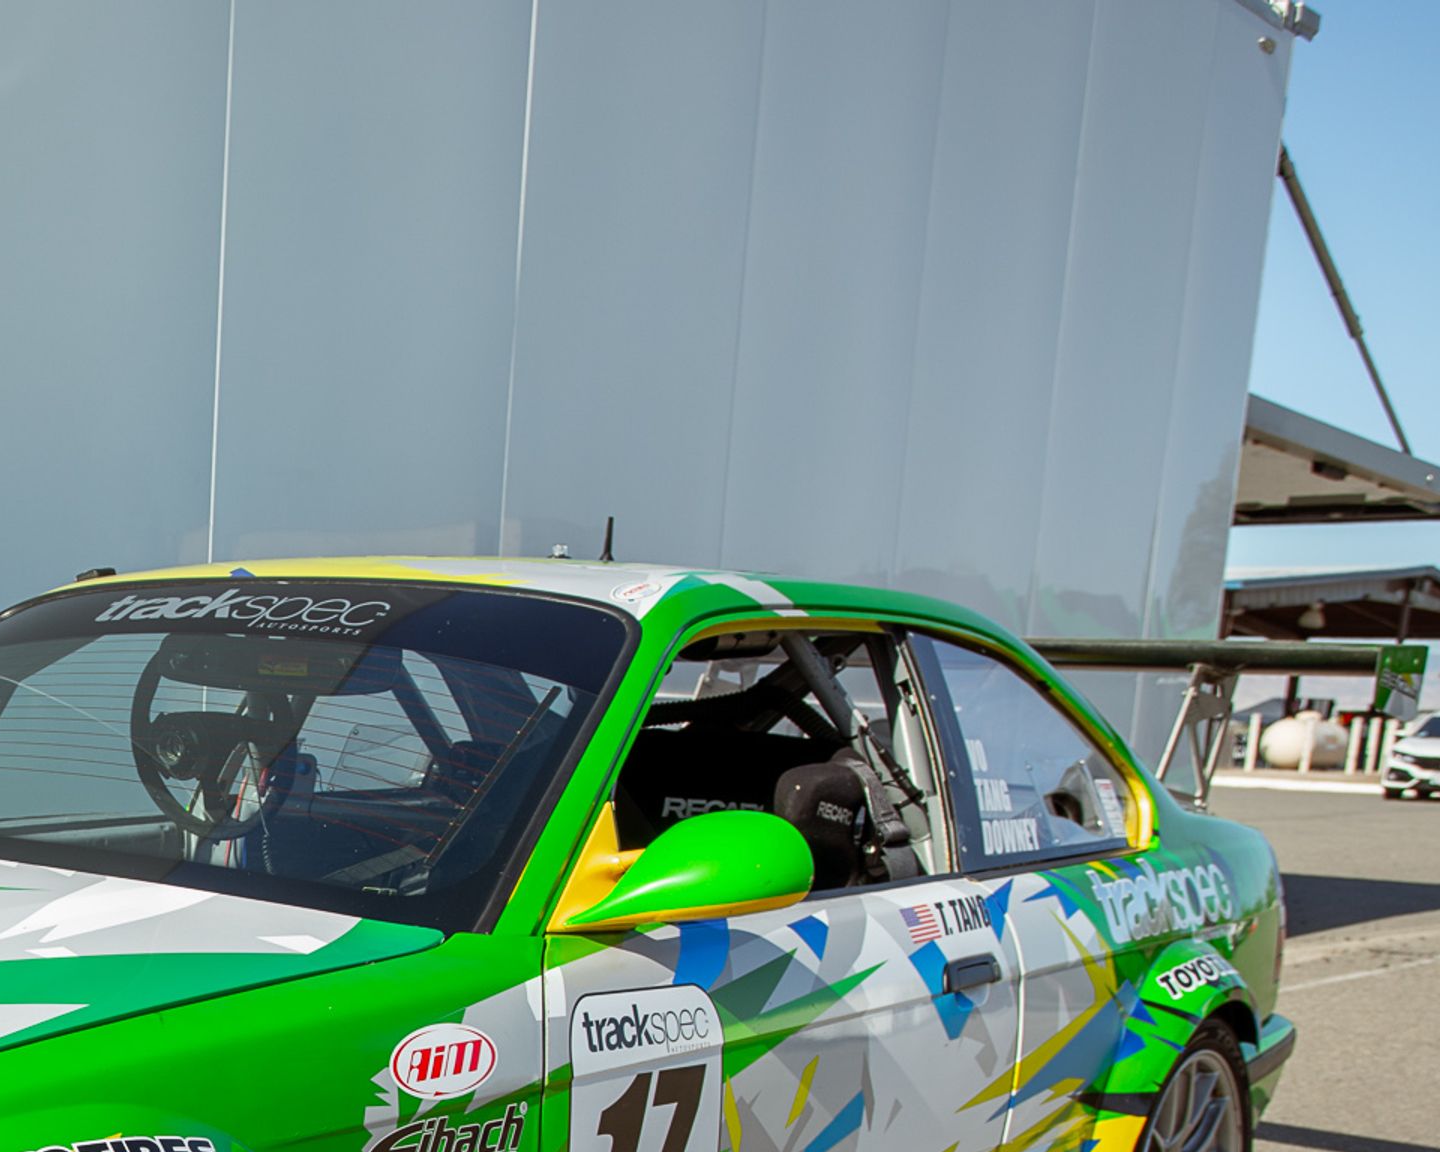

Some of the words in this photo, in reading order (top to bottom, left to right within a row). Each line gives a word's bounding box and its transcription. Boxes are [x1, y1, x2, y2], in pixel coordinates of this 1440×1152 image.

[94, 588, 391, 627] trackspec
[258, 622, 362, 636] AUTOSPORTS
[934, 901, 954, 936] T.
[948, 894, 992, 933] TANG
[1086, 858, 1232, 943] trackspec
[1158, 954, 1219, 998] TOYO
[582, 1004, 709, 1053] trackspec
